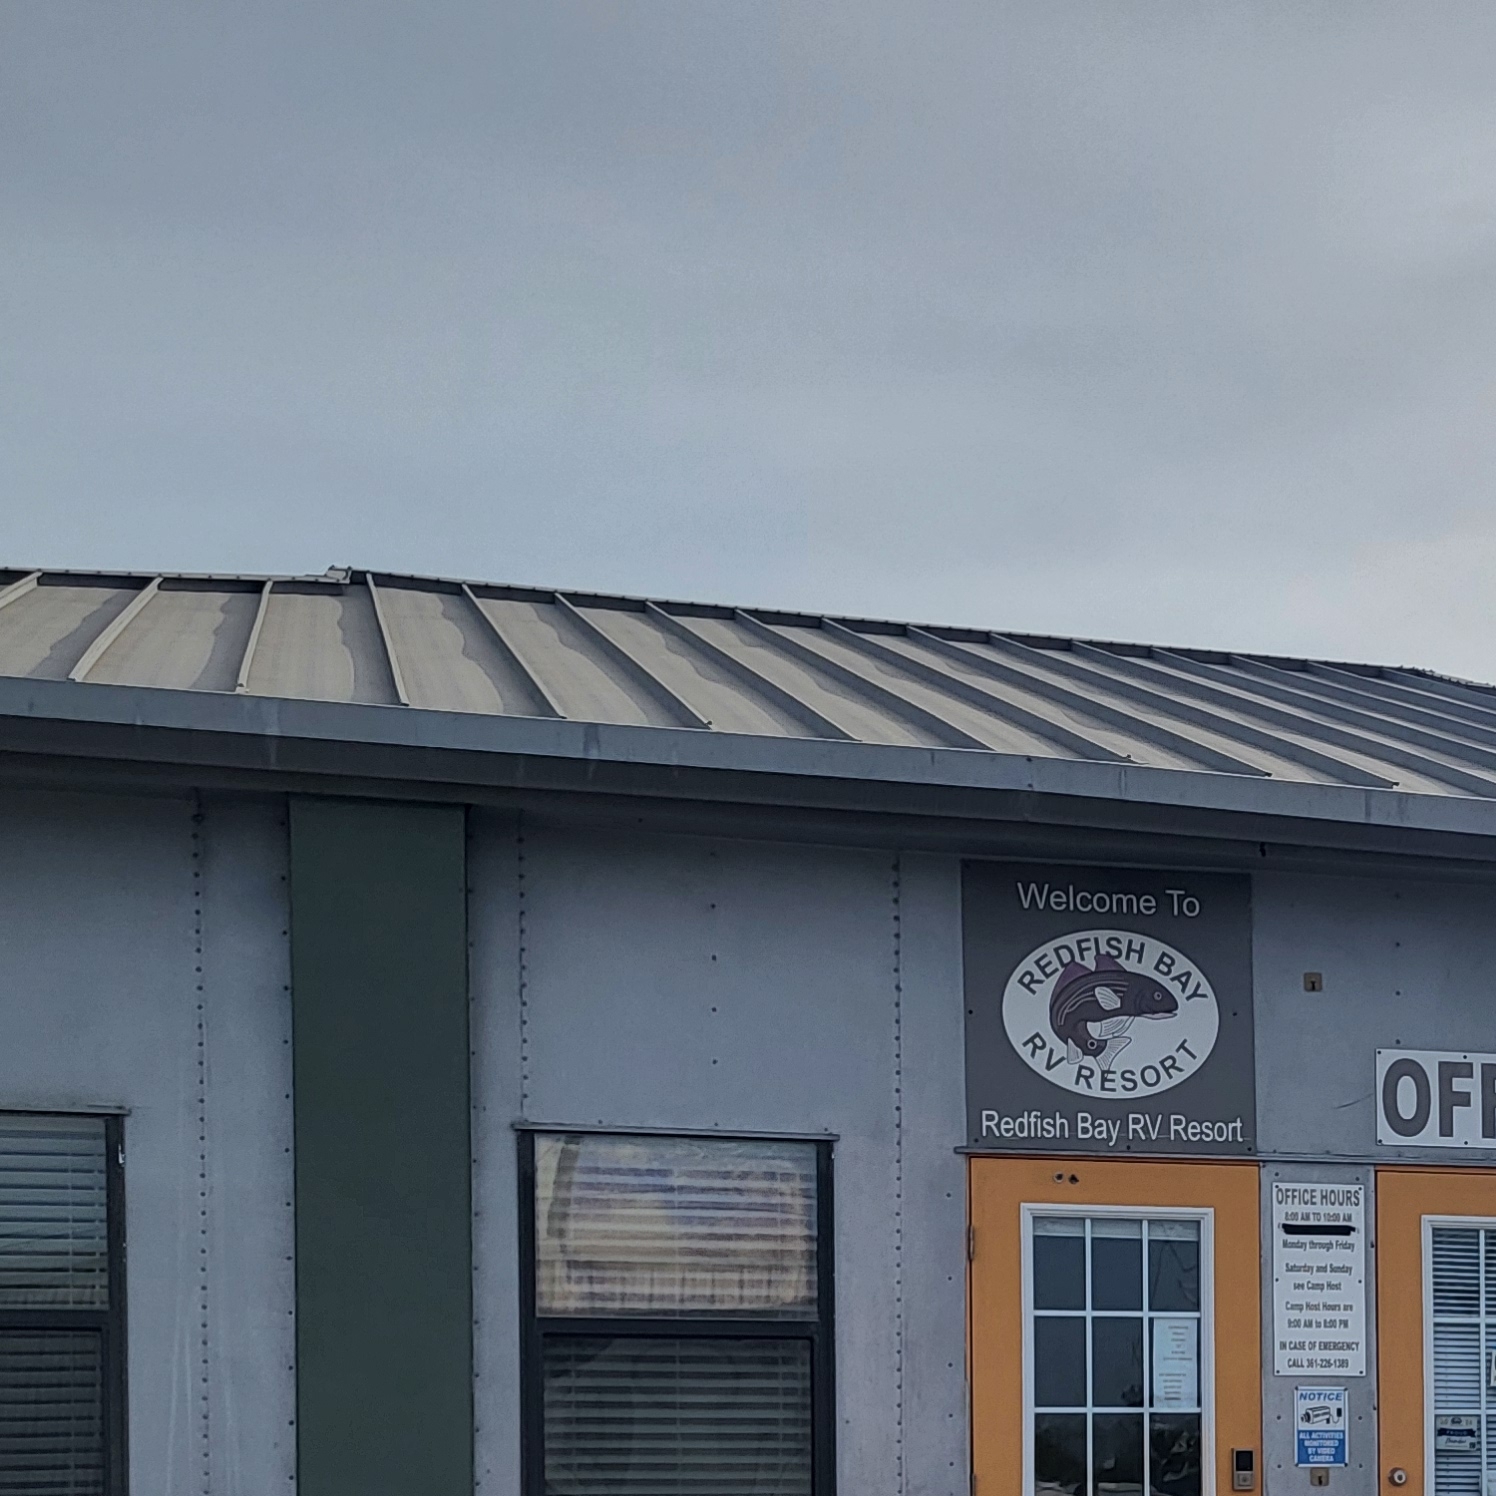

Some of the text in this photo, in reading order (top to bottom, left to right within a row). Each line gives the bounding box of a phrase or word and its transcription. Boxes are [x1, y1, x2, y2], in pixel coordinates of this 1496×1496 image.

[1016, 881, 1200, 917] Welcome To
[1017, 936, 1209, 1003] REDFISH BAY
[1021, 1031, 1198, 1093] RV RESORT
[981, 1110, 1243, 1146] Redfish Bay RV Resort
[1276, 1188, 1360, 1207] OFFICE HOURS
[1284, 1212, 1352, 1222] 8:00 AM TO 10:00 AM
[1282, 1239, 1355, 1252] Monday through Friday
[1285, 1262, 1353, 1276] Saturday and Sunday
[1293, 1281, 1342, 1293] see Camp Host
[1285, 1301, 1304, 1313] Camp
[1305, 1301, 1321, 1311] Host
[1322, 1301, 1341, 1311] Hours
[1303, 1319, 1313, 1328] AM
[1315, 1319, 1322, 1328] to
[1338, 1319, 1349, 1329] PM
[1279, 1341, 1360, 1352] IN CASE OF EMERGENCY
[1287, 1358, 1305, 1368] CALL
[1299, 1392, 1343, 1402] NOTICE
[1299, 1431, 1310, 1439] ALL
